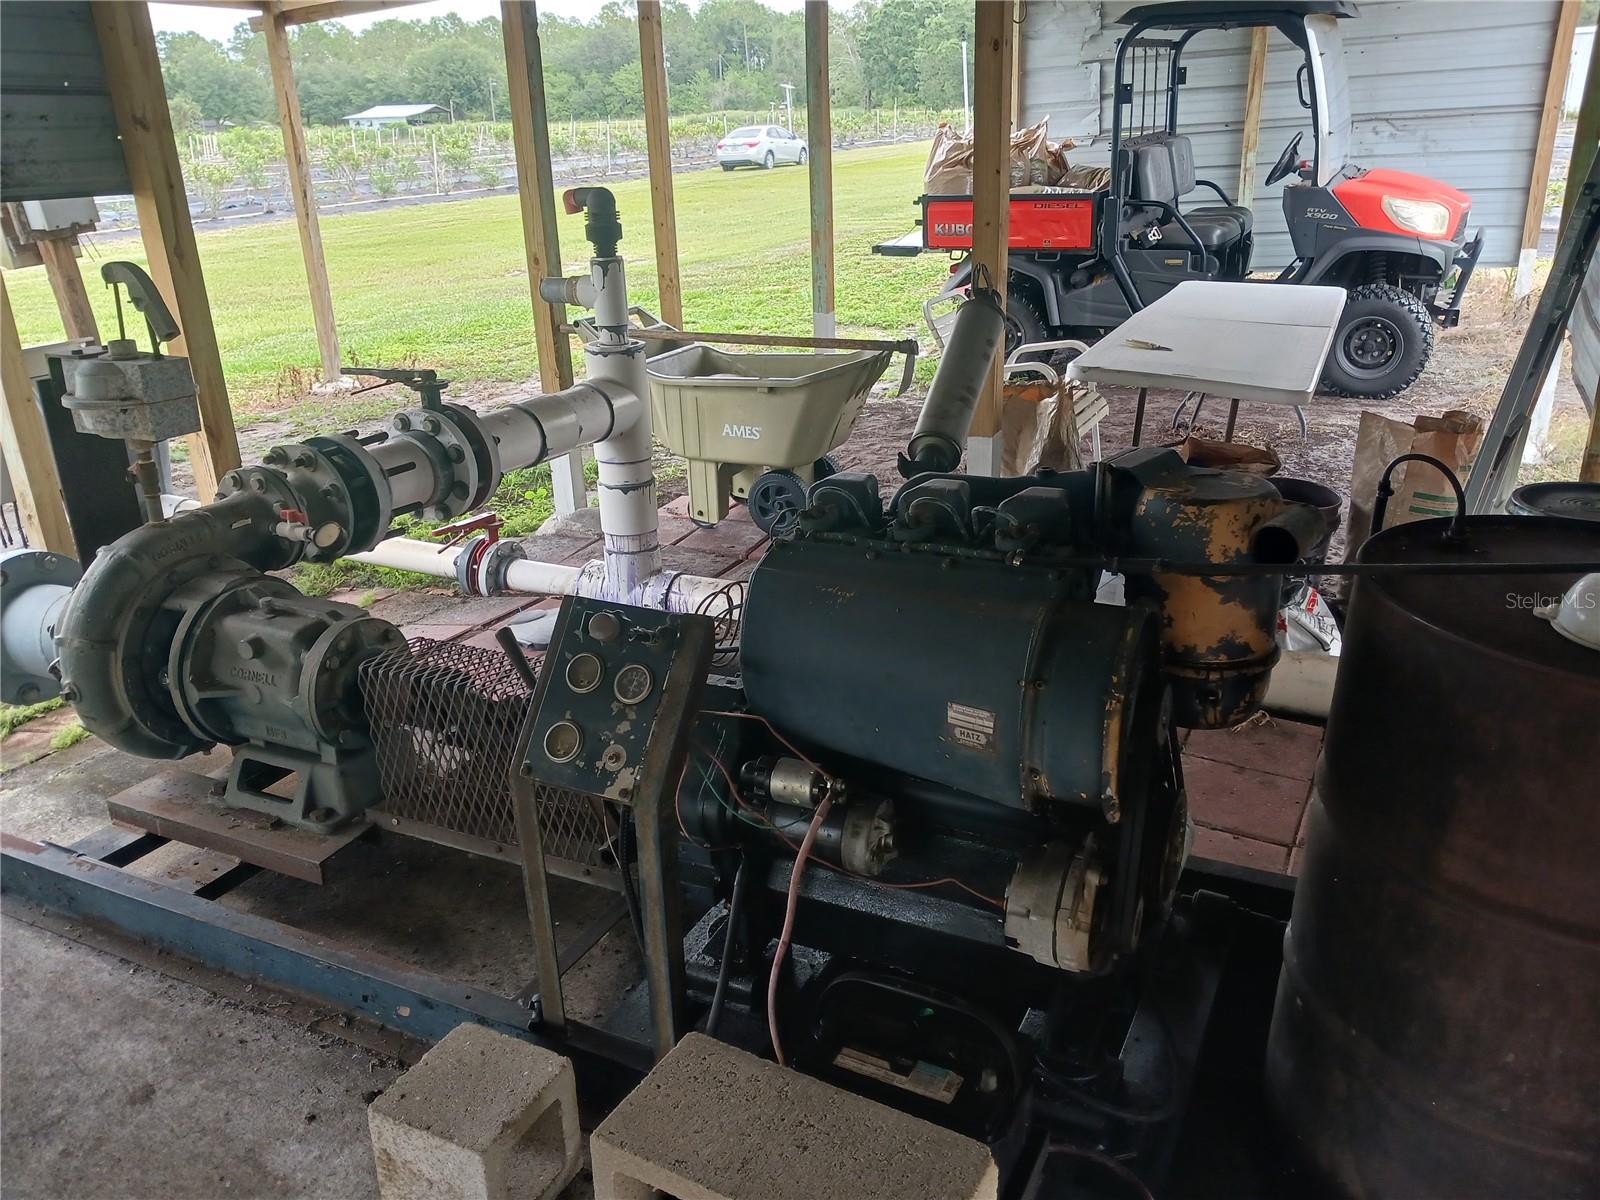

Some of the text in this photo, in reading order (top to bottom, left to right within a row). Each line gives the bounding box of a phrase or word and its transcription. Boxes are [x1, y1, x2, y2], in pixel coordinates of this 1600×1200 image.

[1304, 212, 1339, 220] X900
[934, 223, 973, 236] KUBO
[722, 423, 760, 440] AMES
[230, 665, 279, 688] CORNELL
[959, 729, 982, 741] HATZ
